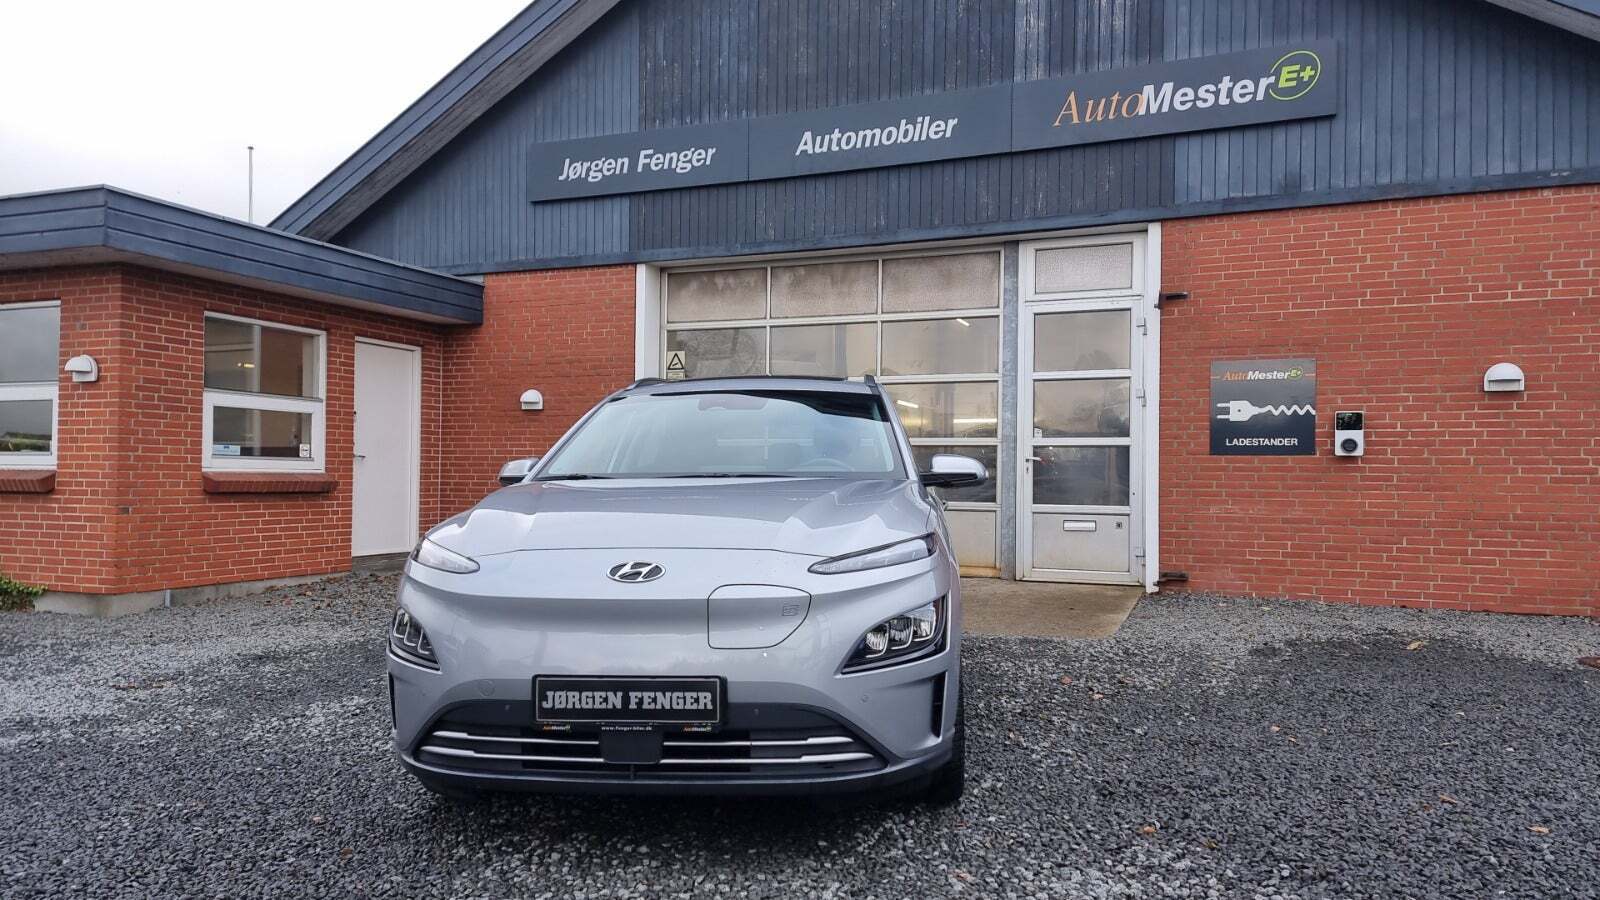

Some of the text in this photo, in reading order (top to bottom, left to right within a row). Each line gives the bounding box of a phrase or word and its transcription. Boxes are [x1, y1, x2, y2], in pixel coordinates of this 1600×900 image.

[1053, 74, 1275, 127] AutoMester
[795, 115, 958, 156] Automobiler
[558, 147, 716, 182] Jørgen Fenger
[1225, 437, 1298, 446] LADESTANDER
[542, 690, 713, 710] JØRGEN FENGER
